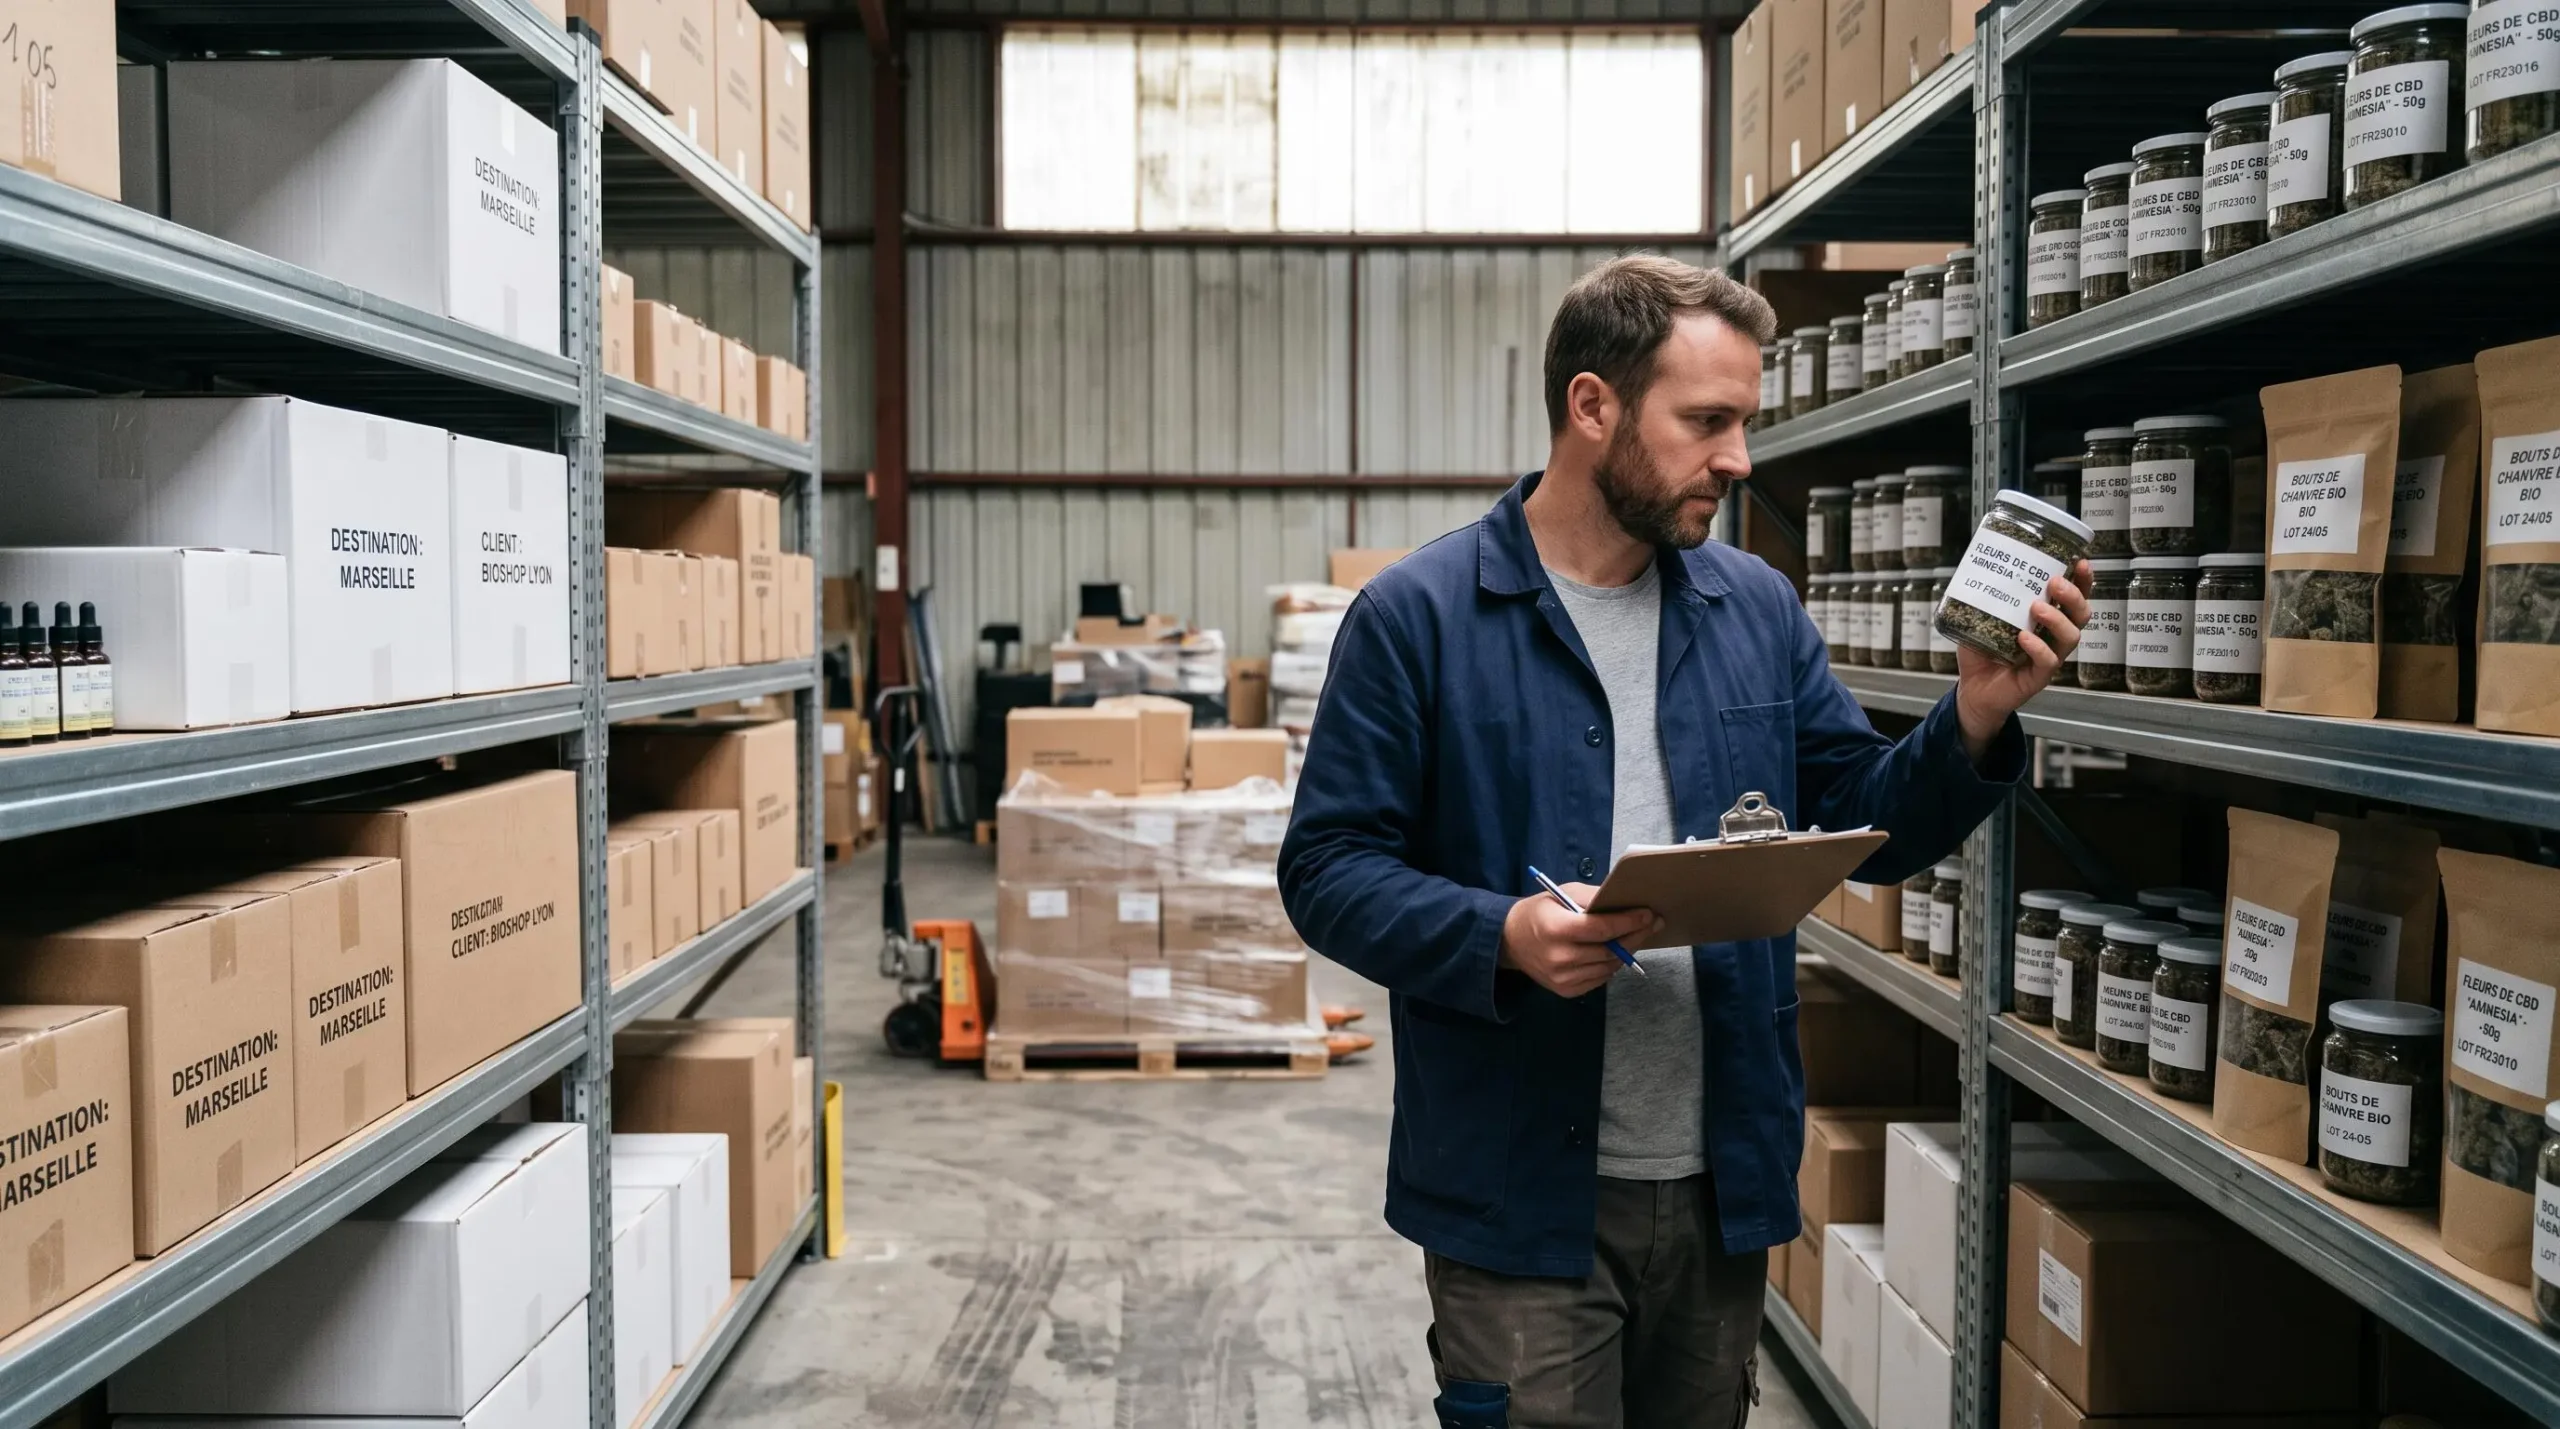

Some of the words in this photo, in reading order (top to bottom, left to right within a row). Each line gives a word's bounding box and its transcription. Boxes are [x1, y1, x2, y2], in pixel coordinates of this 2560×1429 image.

[2503, 15, 2522, 30] DE
[2526, 9, 2559, 25] CBD
[2469, 73, 2484, 89] LOT
[2486, 61, 2539, 82] FR23016
[2375, 84, 2391, 97] DE
[2395, 79, 2424, 93] CBD
[2403, 96, 2426, 109] 50g
[2347, 134, 2360, 149] LOT
[2290, 149, 2308, 161] 50g
[2231, 159, 2245, 170] DE
[475, 156, 541, 211] DESTINATION:
[2160, 192, 2174, 203] DE
[2176, 190, 2200, 201] CBD
[2218, 195, 2257, 209] FR23010
[480, 189, 535, 236] MARSEILLE
[2182, 203, 2201, 215] 50g
[2150, 227, 2187, 239] FR23010
[2510, 447, 2551, 465] BOUTS
[2095, 479, 2106, 488] DE
[2108, 478, 2128, 487] CBD
[2156, 472, 2177, 482] CBD
[2291, 472, 2324, 486] BOUTS
[2325, 470, 2341, 483] DE
[2497, 466, 2554, 485] CHANVRE
[2281, 487, 2326, 503] CHANVRE
[2326, 486, 2346, 499] BIO
[2519, 487, 2542, 501] BIO
[2298, 505, 2316, 518] BIO
[2499, 513, 2520, 527] LOT
[2521, 511, 2553, 525] 24/05
[2283, 526, 2300, 539] LOT
[2300, 525, 2328, 538] 24/05
[331, 527, 423, 556] DESTINATION:
[340, 565, 415, 589] MARSEILLE
[482, 562, 526, 584] BIOSHOP
[528, 565, 552, 584] LYON
[2012, 557, 2028, 571] DE
[2029, 565, 2050, 582] CBD
[1965, 577, 1983, 591] LOT
[2146, 613, 2158, 622] DE
[2161, 612, 2182, 622] CBD
[2217, 614, 2230, 623] DE
[2233, 614, 2257, 624] CBD
[2164, 625, 2182, 636] 50g
[2239, 627, 2258, 639] 50g
[451, 929, 490, 959] CLIENT:
[490, 910, 530, 944] BIOSHOP
[532, 901, 554, 926] LYON
[2268, 922, 2286, 937] CBD
[309, 965, 394, 1019] DESTINATION:
[2134, 991, 2150, 1002] DE
[2462, 974, 2499, 998] FLEURS
[2499, 987, 2515, 1003] DE
[2515, 992, 2540, 1011] CBD
[320, 997, 386, 1047] MARSEILLE
[2104, 1016, 2118, 1026] LOT
[2159, 1009, 2169, 1020] DE
[2170, 1012, 2191, 1023] CBD
[2457, 1037, 2474, 1054] LOT
[2474, 1044, 2518, 1071] FR23010
[172, 1029, 278, 1098] DESTINATION:
[185, 1066, 268, 1130] MARSEILLE
[2325, 1084, 2358, 1104] BOUTS
[2361, 1095, 2380, 1108] DE
[2367, 1112, 2392, 1125] BIO
[2325, 1124, 2341, 1137] LOT
[0, 1142, 97, 1213] ARSEILLE
[2540, 1246, 2557, 1263] LOT
